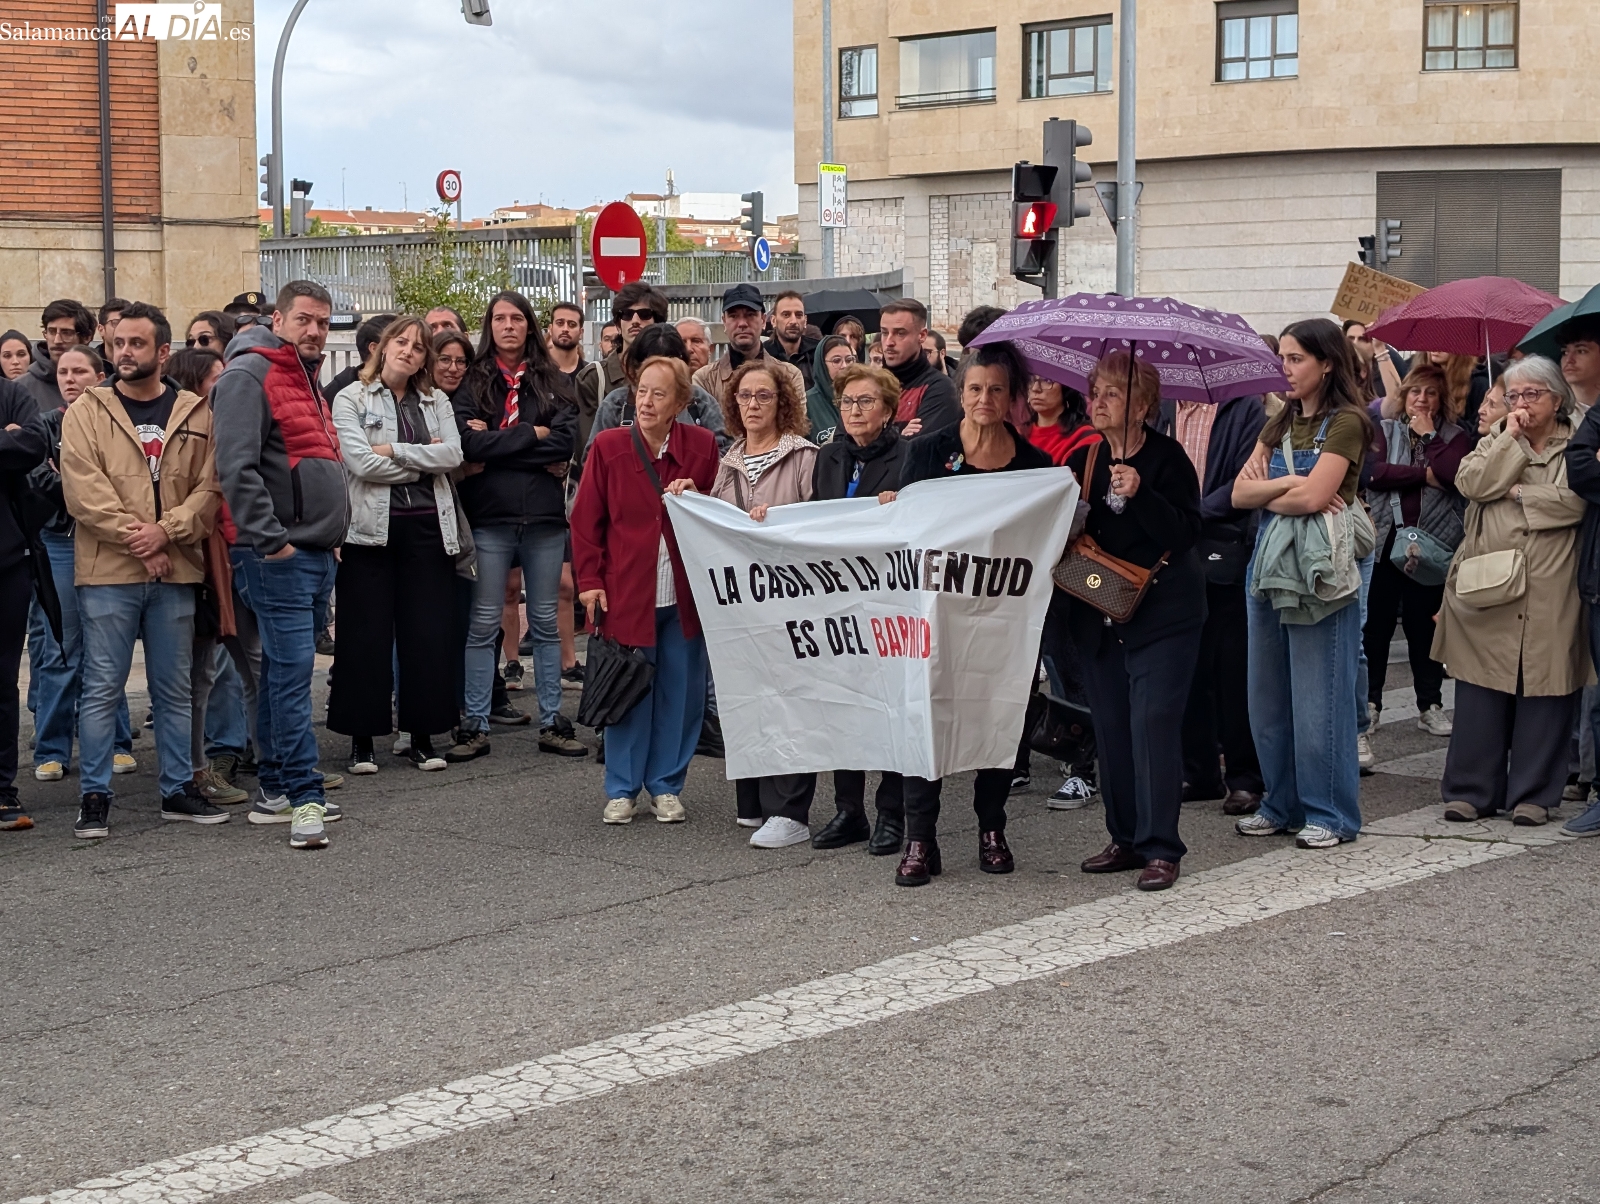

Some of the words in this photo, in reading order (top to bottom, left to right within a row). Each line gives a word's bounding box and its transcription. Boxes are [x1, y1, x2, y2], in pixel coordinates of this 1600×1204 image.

[445, 180, 457, 191] 30
[1348, 275, 1360, 286] DE
[1364, 281, 1378, 292] LA
[1351, 265, 1369, 278] LOS
[1372, 272, 1411, 293] ESPACIOS
[1345, 285, 1359, 295] NO
[1338, 294, 1355, 310] SE
[708, 565, 743, 606] LA
[749, 562, 815, 602] CASA
[806, 560, 850, 595] DE
[841, 556, 880, 591] LA
[885, 548, 1034, 598] JUVENTUD
[785, 619, 820, 659] ES
[824, 614, 869, 656] DEL
[870, 615, 931, 659] BARRIO
